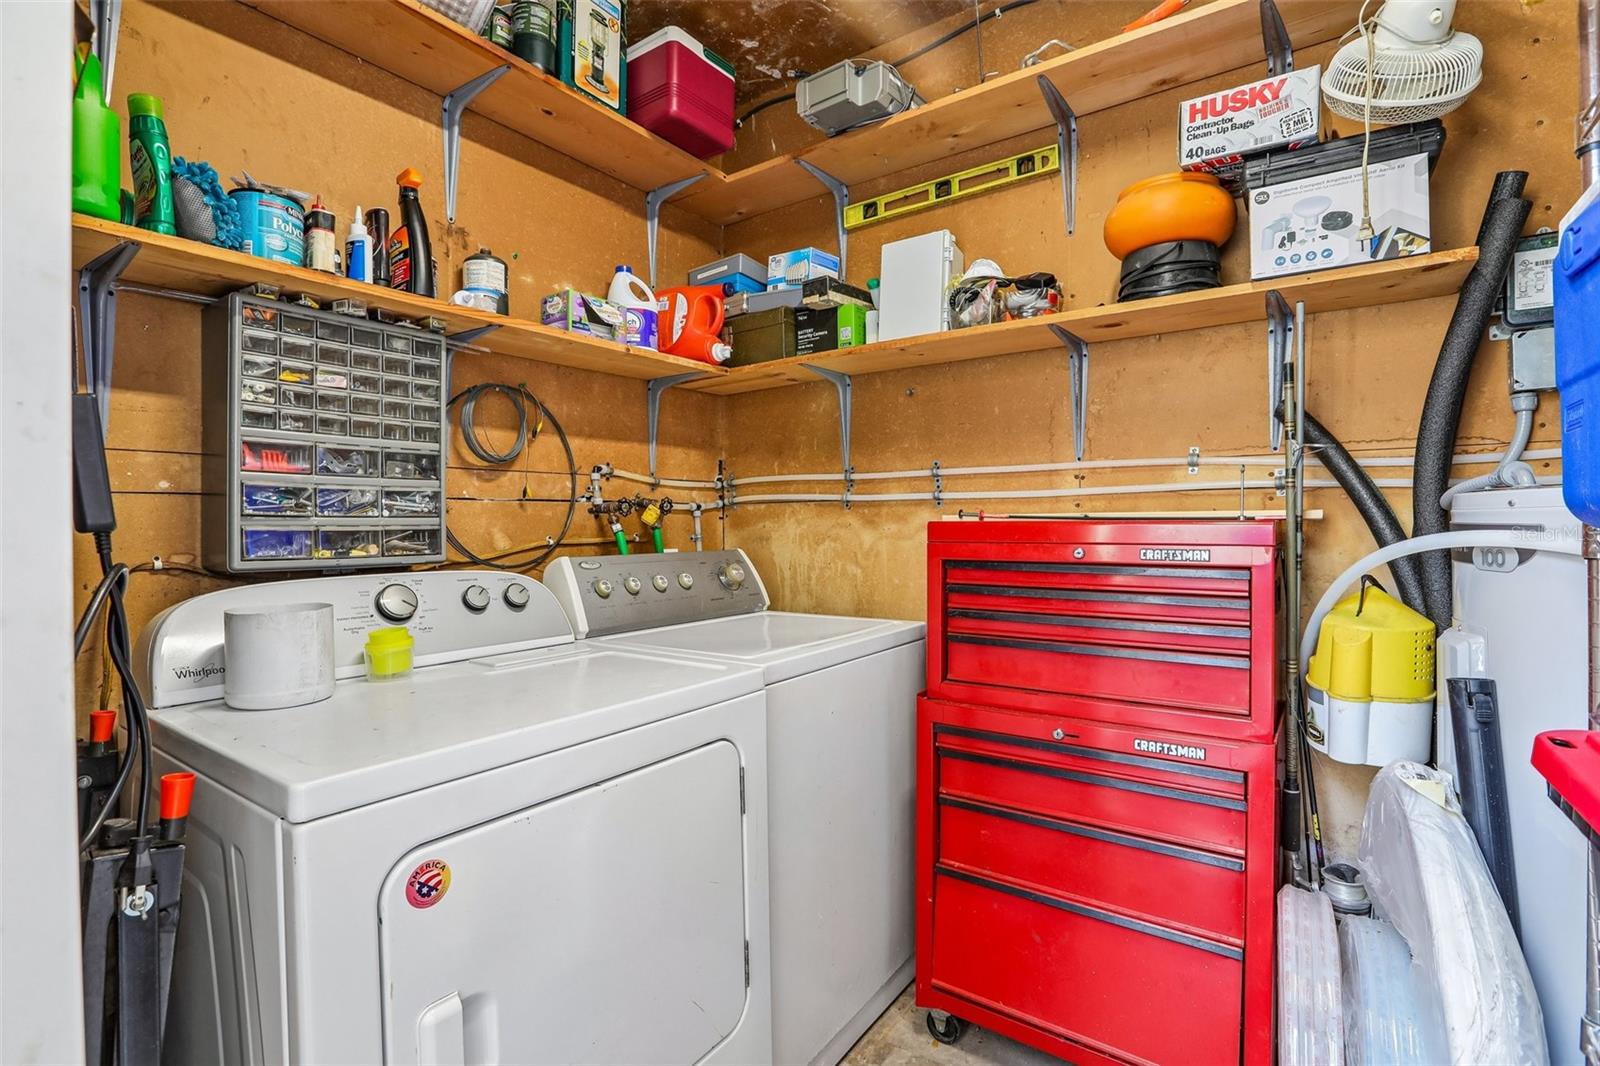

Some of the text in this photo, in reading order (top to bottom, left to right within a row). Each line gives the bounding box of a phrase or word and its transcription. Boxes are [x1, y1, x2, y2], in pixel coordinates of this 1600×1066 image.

[1188, 77, 1288, 123] HUSKY
[1186, 116, 1235, 133] Contractor
[1230, 119, 1255, 132] Bags
[1285, 116, 1308, 131] 2 MIL
[1186, 145, 1226, 160] 40 BAGS
[1140, 549, 1210, 562] CRAFTSMAN
[1480, 547, 1506, 568] 100
[174, 667, 226, 680] Whirlpoo
[1134, 739, 1205, 760] CRAFTSMAN
[409, 861, 446, 888] AMERICA
